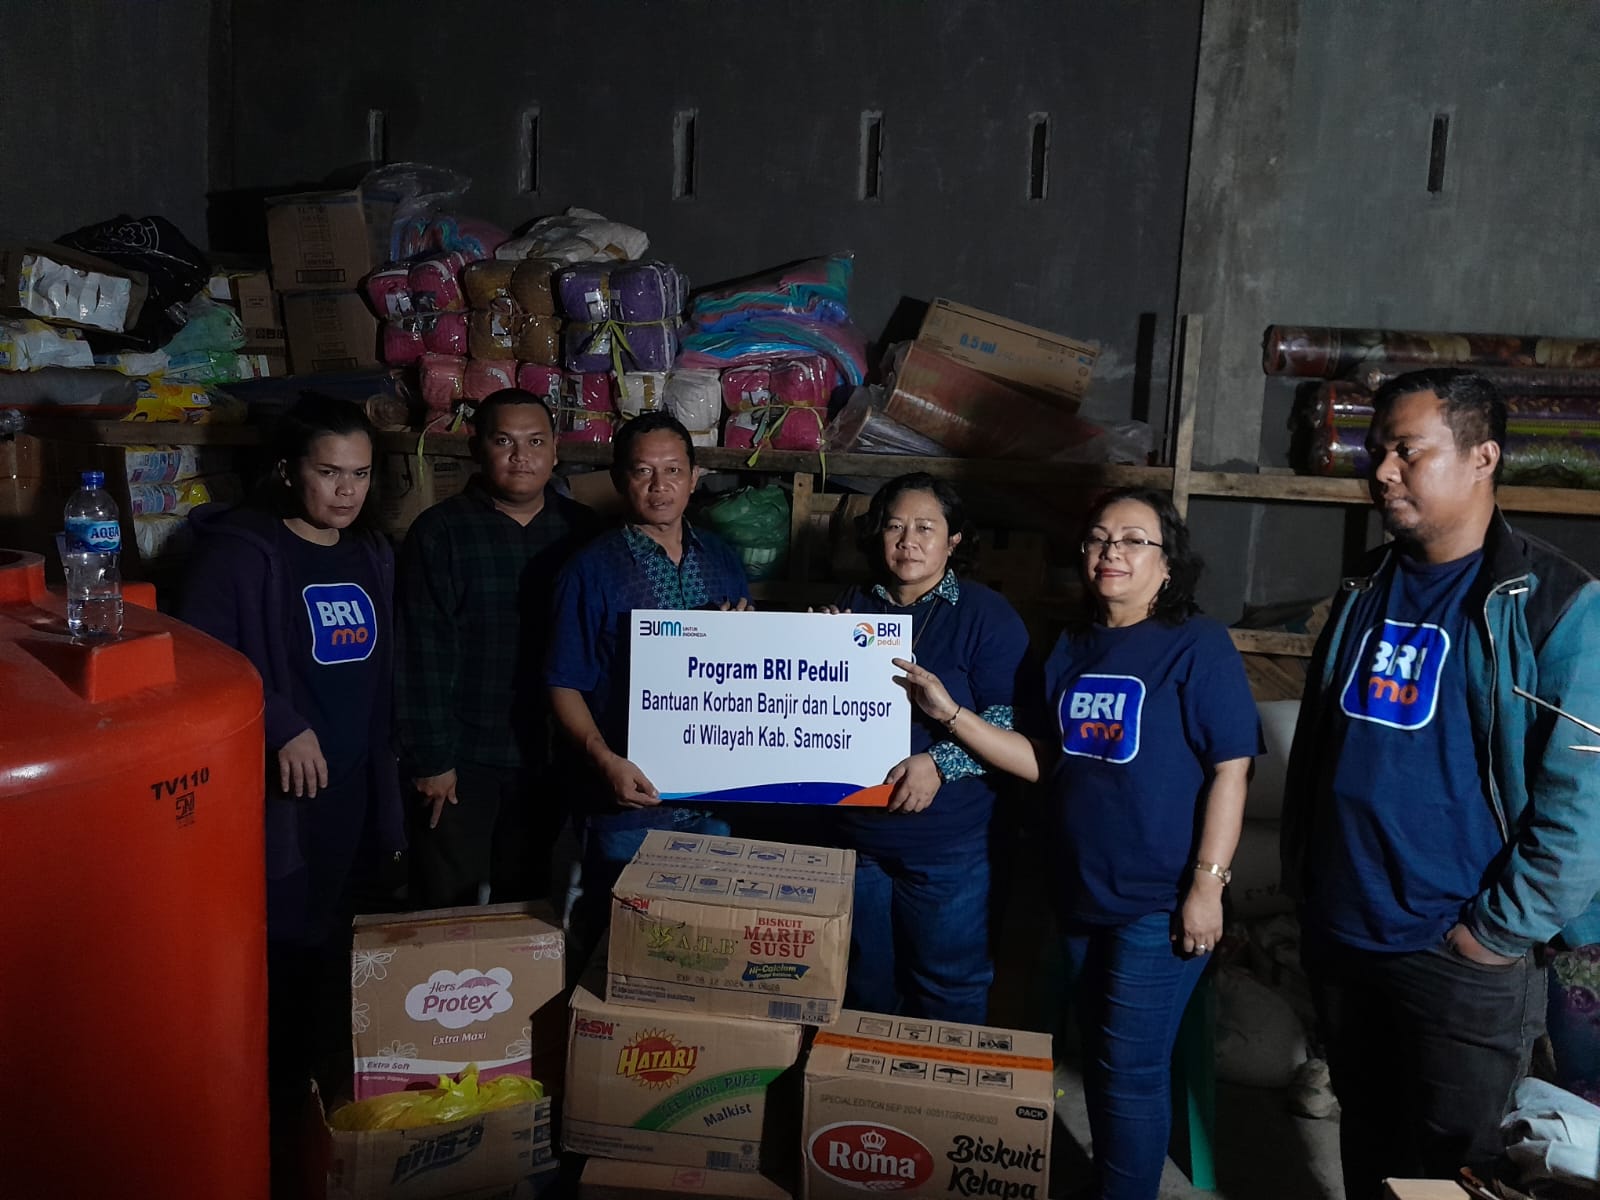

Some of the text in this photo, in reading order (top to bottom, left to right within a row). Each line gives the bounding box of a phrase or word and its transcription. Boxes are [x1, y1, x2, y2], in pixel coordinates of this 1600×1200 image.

[91, 526, 120, 539] AQUA
[315, 600, 366, 627] BRI
[331, 626, 368, 646] mo
[877, 622, 901, 637] BRI
[877, 638, 901, 647] peduli
[688, 656, 848, 684] Program BRI Peduli
[1371, 640, 1428, 681] BRI
[1368, 676, 1419, 705] mo
[642, 690, 891, 721] Bantuan Korban Banjir dan Longsor
[1069, 691, 1127, 720] BRI
[683, 724, 851, 751] di Wilayah Kab. Samosir
[1081, 721, 1124, 741] mo
[150, 767, 209, 801] TV110
[758, 917, 803, 928] BISKUIT
[744, 926, 815, 945] MARIE
[750, 942, 806, 958] SUSU
[749, 964, 796, 976] Hi-Calcium
[429, 982, 457, 994] Hers
[422, 991, 498, 1014] Protex
[432, 1031, 487, 1047] Extra Maxi
[367, 1061, 411, 1071] Extra Soft
[616, 1045, 698, 1078] HATARI
[724, 1072, 760, 1089] PUFF
[820, 1094, 852, 1106] SPECIAL
[852, 1097, 885, 1110] EDITION
[703, 1103, 752, 1128] Malkist
[1017, 1108, 1045, 1119] PACK
[828, 1140, 916, 1180] Roma
[946, 1135, 1046, 1172] Biskuit
[947, 1164, 1039, 1200] Kelapa
